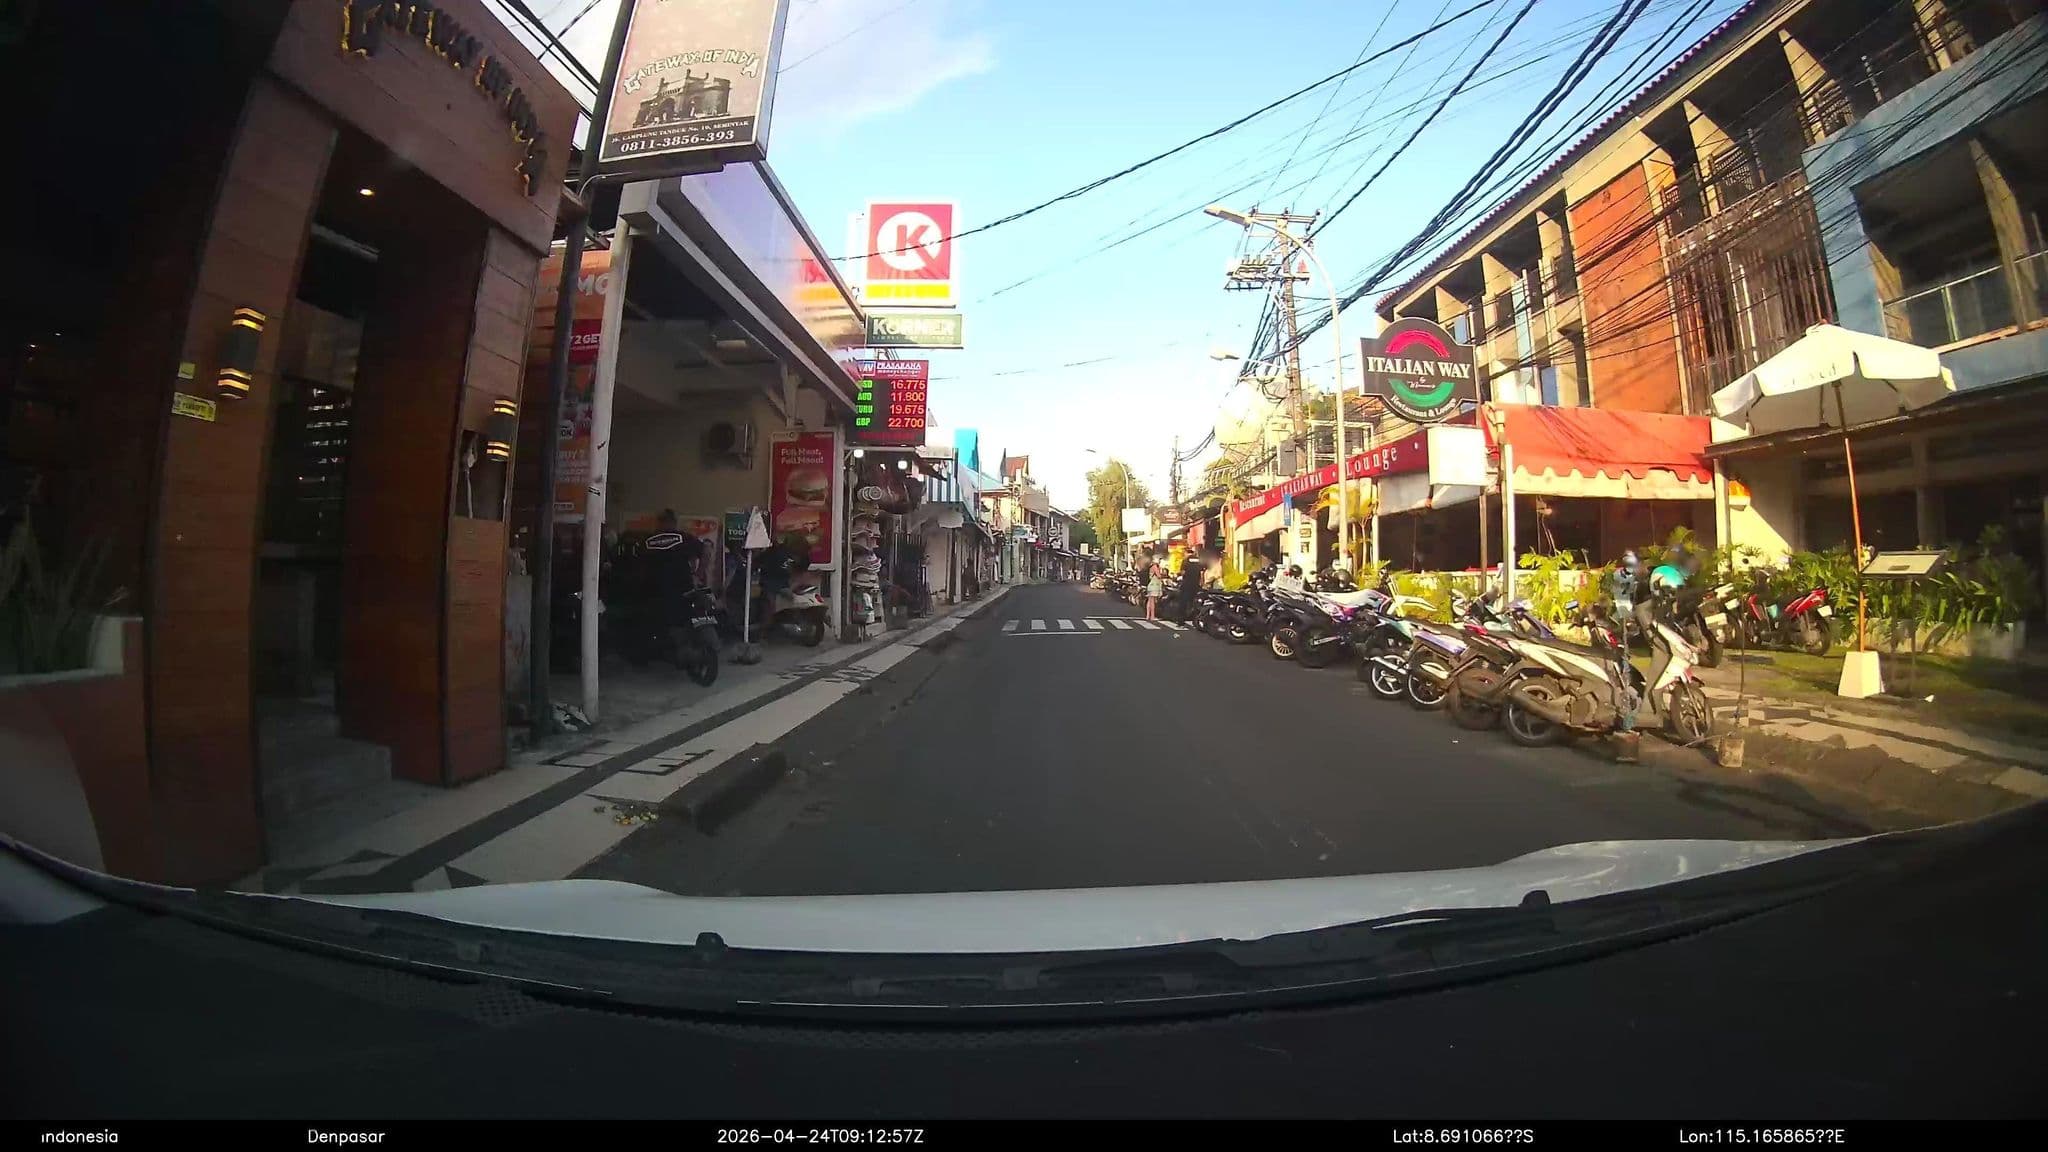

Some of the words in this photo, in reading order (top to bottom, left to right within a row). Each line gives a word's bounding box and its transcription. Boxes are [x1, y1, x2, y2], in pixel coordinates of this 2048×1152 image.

[624, 51, 700, 95] GATEWAY
[701, 49, 722, 64] OF
[724, 49, 760, 78] INDIA
[620, 130, 735, 152] 0811-3856-393
[1366, 356, 1435, 376] ITALIAN
[1438, 361, 1472, 379] WAY
[890, 380, 926, 390] 16.775
[888, 418, 925, 428] 22.700
[1428, 408, 1435, 417] &
[1345, 447, 1398, 476] Lounge
